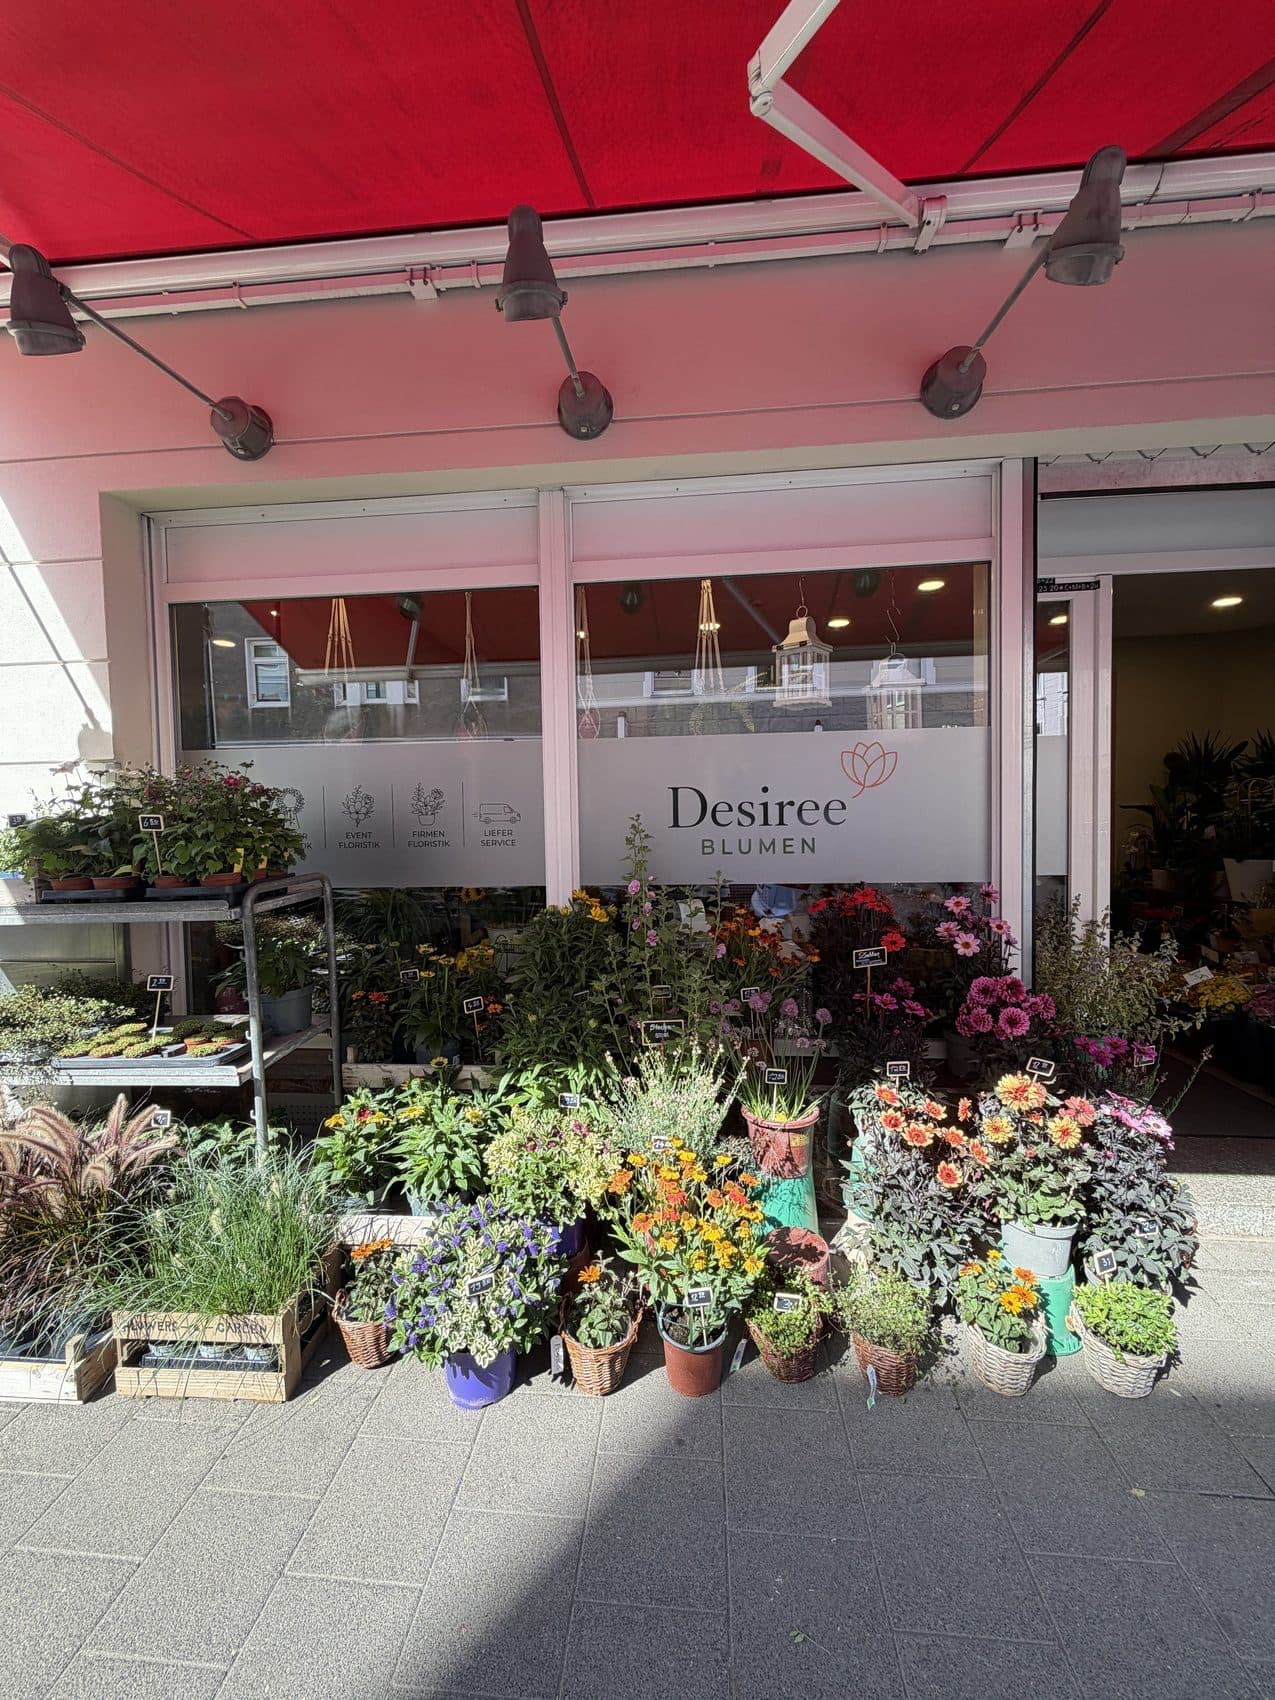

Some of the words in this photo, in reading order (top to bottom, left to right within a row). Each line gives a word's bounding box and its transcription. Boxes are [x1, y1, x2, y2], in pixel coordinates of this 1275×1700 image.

[667, 786, 847, 828] Desiree
[345, 831, 373, 840] EVENT
[412, 830, 445, 838] FIRMEN
[484, 829, 513, 837] LIEFER
[338, 841, 381, 849] FLORISTIK
[408, 840, 450, 848] FLORISTIK
[480, 839, 517, 847] SERVICE
[701, 838, 816, 855] BLUMEN
